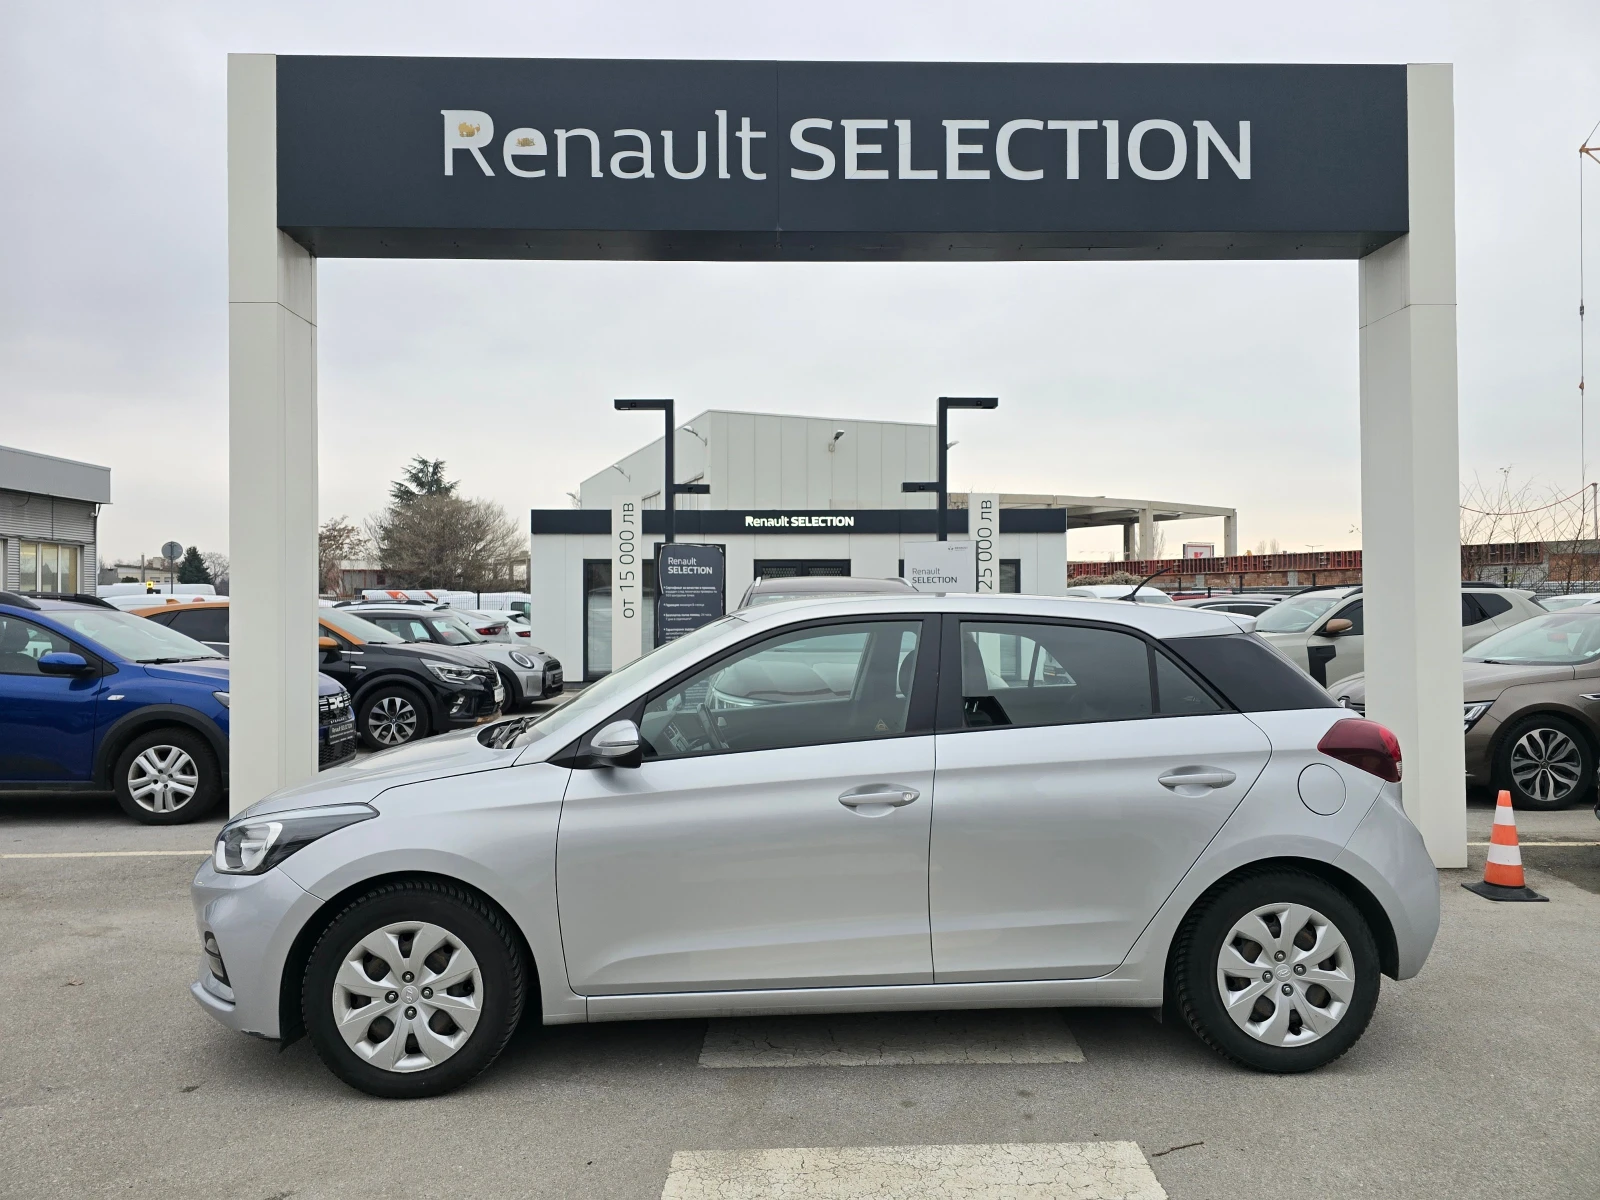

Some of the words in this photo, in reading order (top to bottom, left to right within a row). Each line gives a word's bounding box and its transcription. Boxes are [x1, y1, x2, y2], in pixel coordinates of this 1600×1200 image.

[440, 109, 767, 180] Renault
[789, 118, 1251, 181] SELECTION
[623, 502, 634, 525] лв
[745, 515, 789, 527] Renault
[790, 516, 855, 527] SELECTION
[980, 500, 992, 522] лв
[619, 530, 635, 565] 000
[977, 527, 993, 562] 000
[667, 556, 697, 566] Renault
[667, 566, 713, 575] SELECTION
[619, 571, 635, 591] 15
[912, 567, 941, 576] Renault
[912, 576, 958, 584] SELECTION
[978, 568, 993, 590] 25
[623, 598, 635, 618] от
